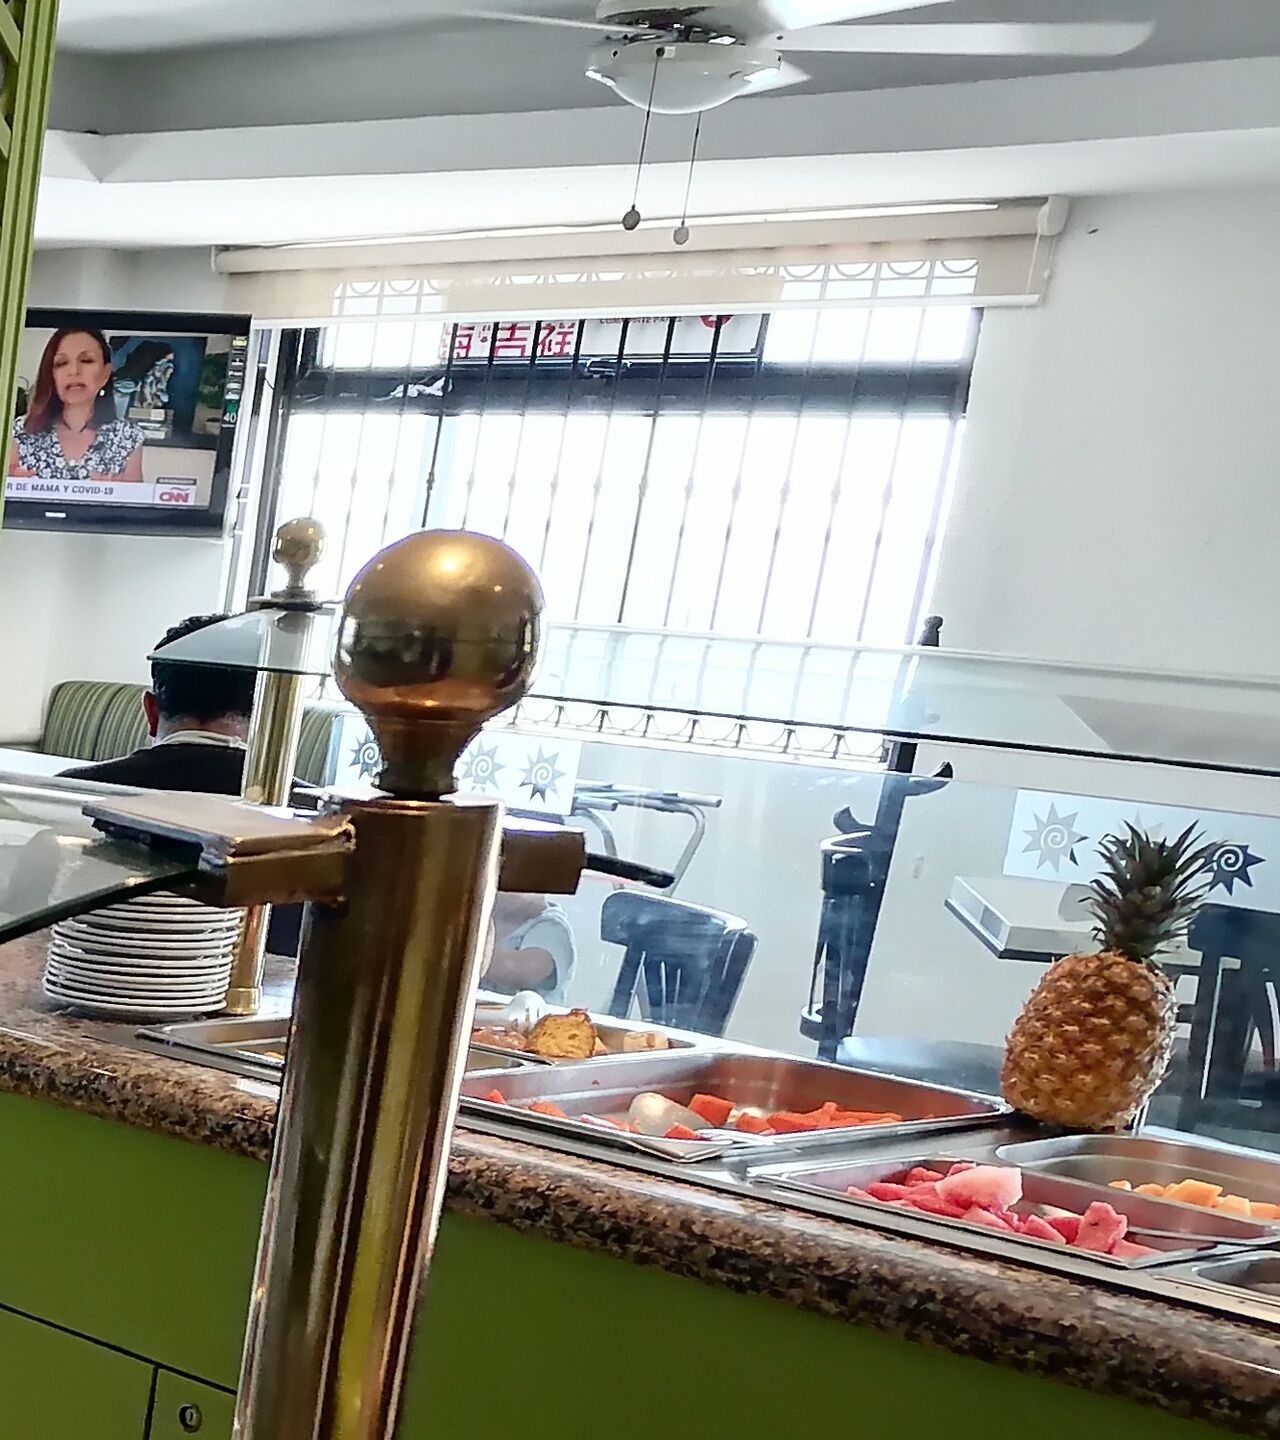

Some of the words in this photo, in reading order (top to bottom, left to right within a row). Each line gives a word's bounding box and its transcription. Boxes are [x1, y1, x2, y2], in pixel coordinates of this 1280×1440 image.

[16, 483, 28, 491] DE
[31, 484, 60, 493] MAMA
[63, 485, 70, 494] Y
[71, 485, 115, 496] COVID-19
[159, 492, 190, 503] CNN
